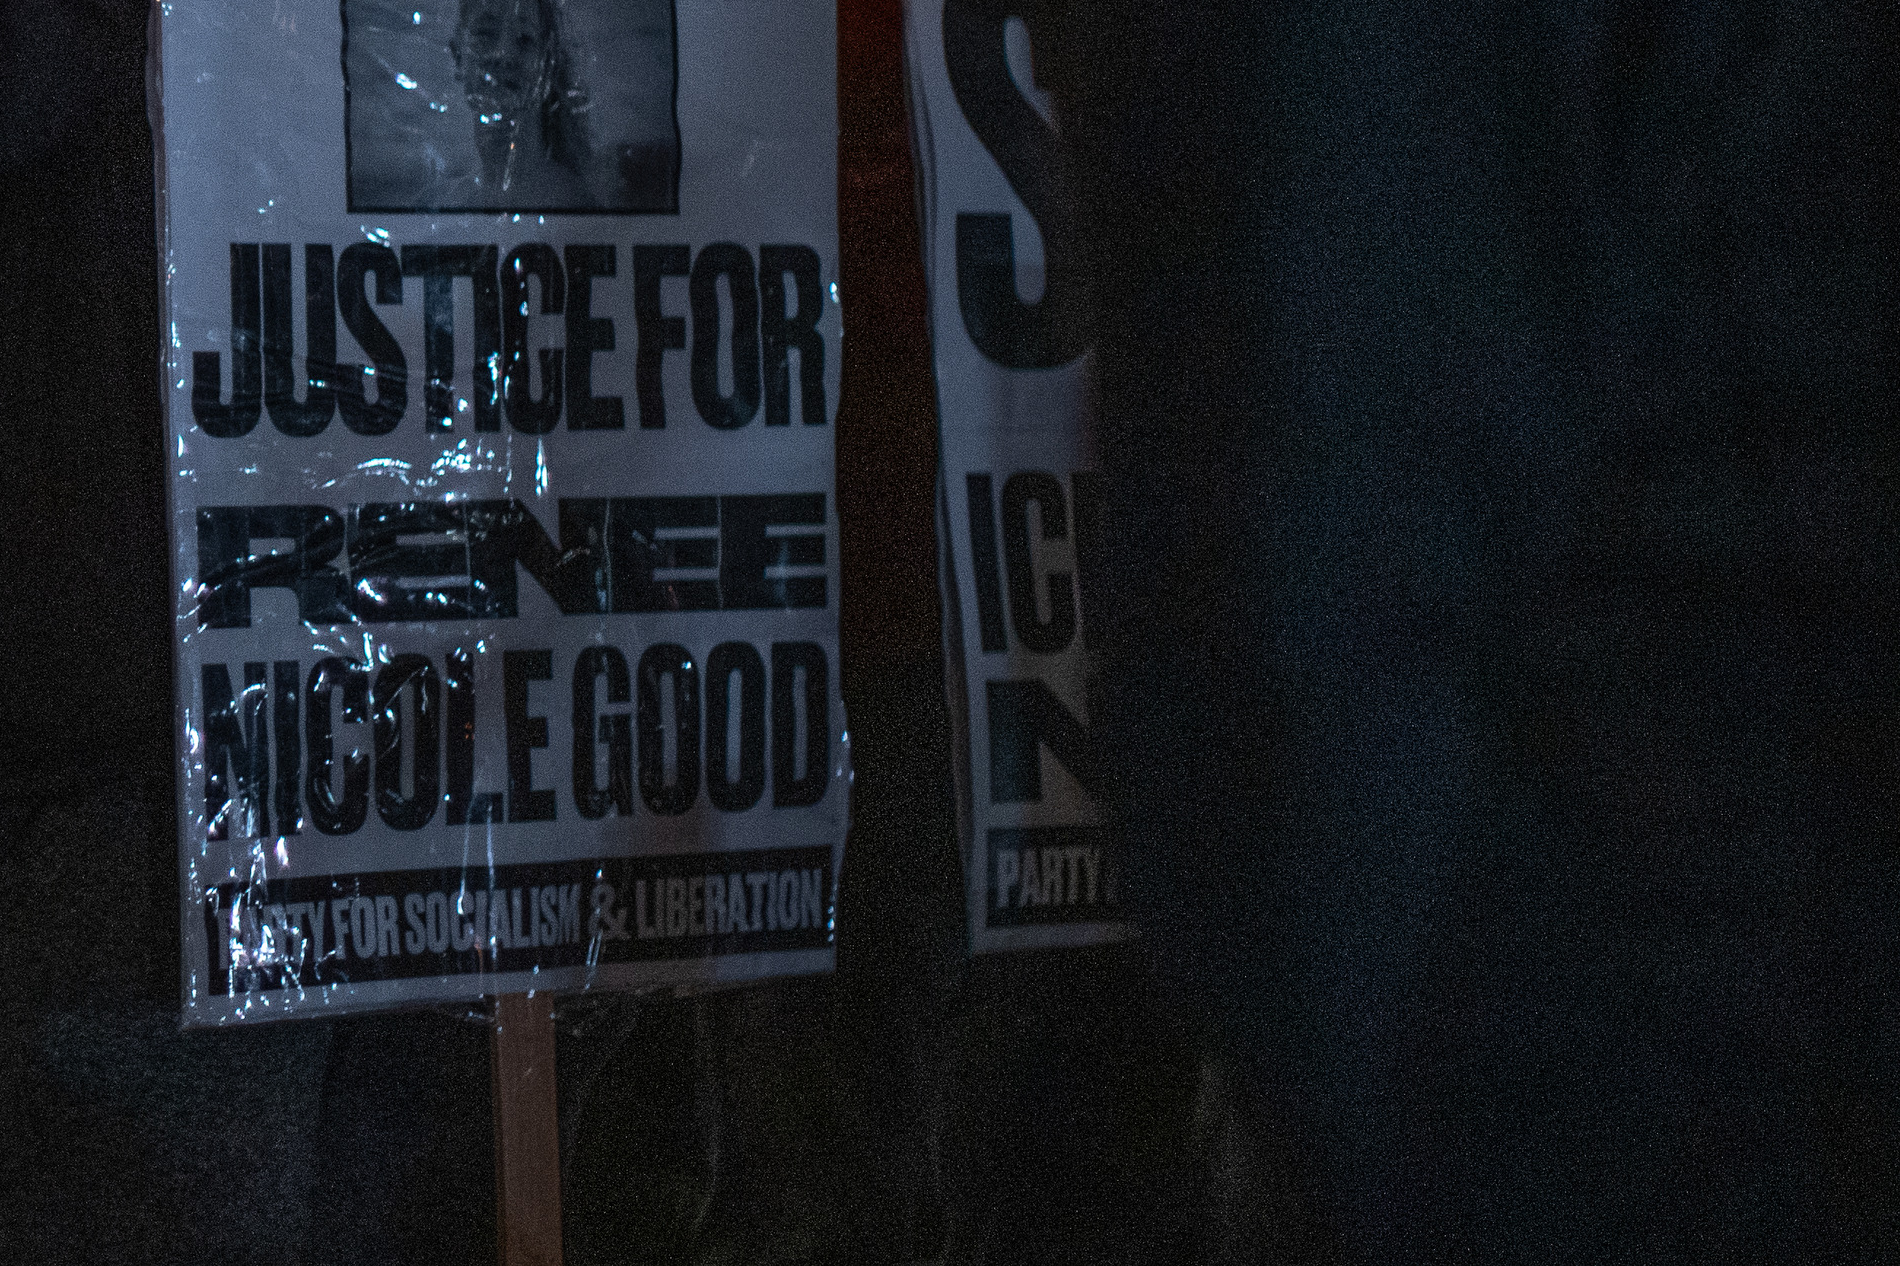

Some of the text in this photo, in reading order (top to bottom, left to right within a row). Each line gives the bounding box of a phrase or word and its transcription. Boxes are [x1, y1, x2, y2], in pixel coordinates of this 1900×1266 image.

[192, 242, 828, 438] JUSTICE FOR
[196, 493, 828, 630] RENEE
[201, 640, 829, 841] NICOLE GOOD
[330, 895, 401, 960] FOR
[404, 883, 581, 955] SOCIALISM
[589, 882, 628, 941] &
[636, 867, 823, 936] LIBERATION
